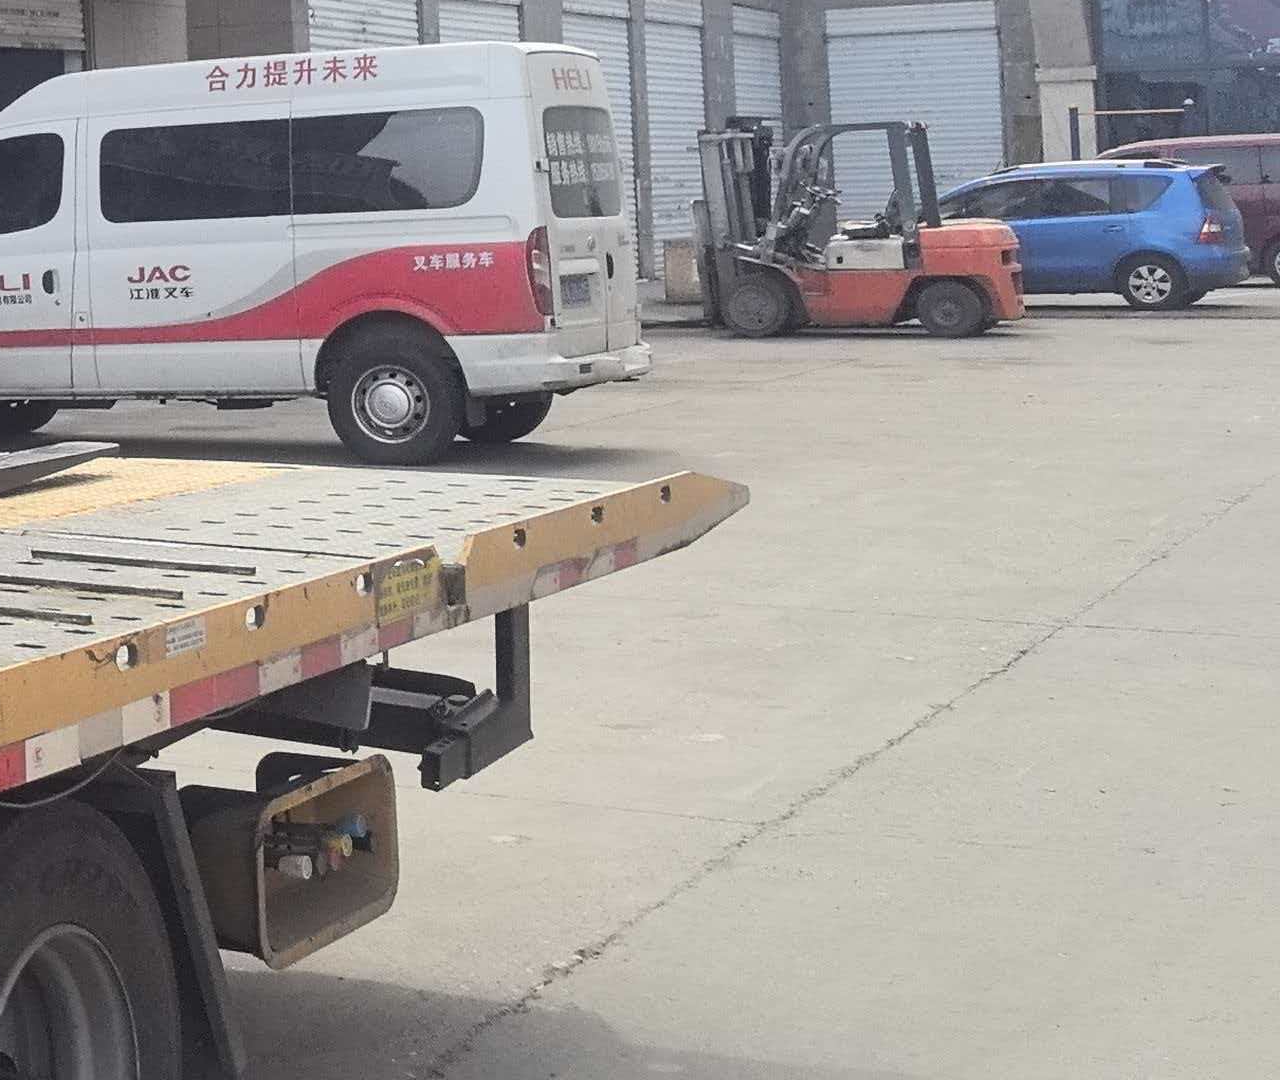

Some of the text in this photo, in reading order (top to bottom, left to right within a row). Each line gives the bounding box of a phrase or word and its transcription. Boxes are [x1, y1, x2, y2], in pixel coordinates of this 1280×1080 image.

[205, 53, 378, 93] 合力提升未来
[127, 264, 192, 283] JAC
[129, 286, 194, 300] 江淮叉车
